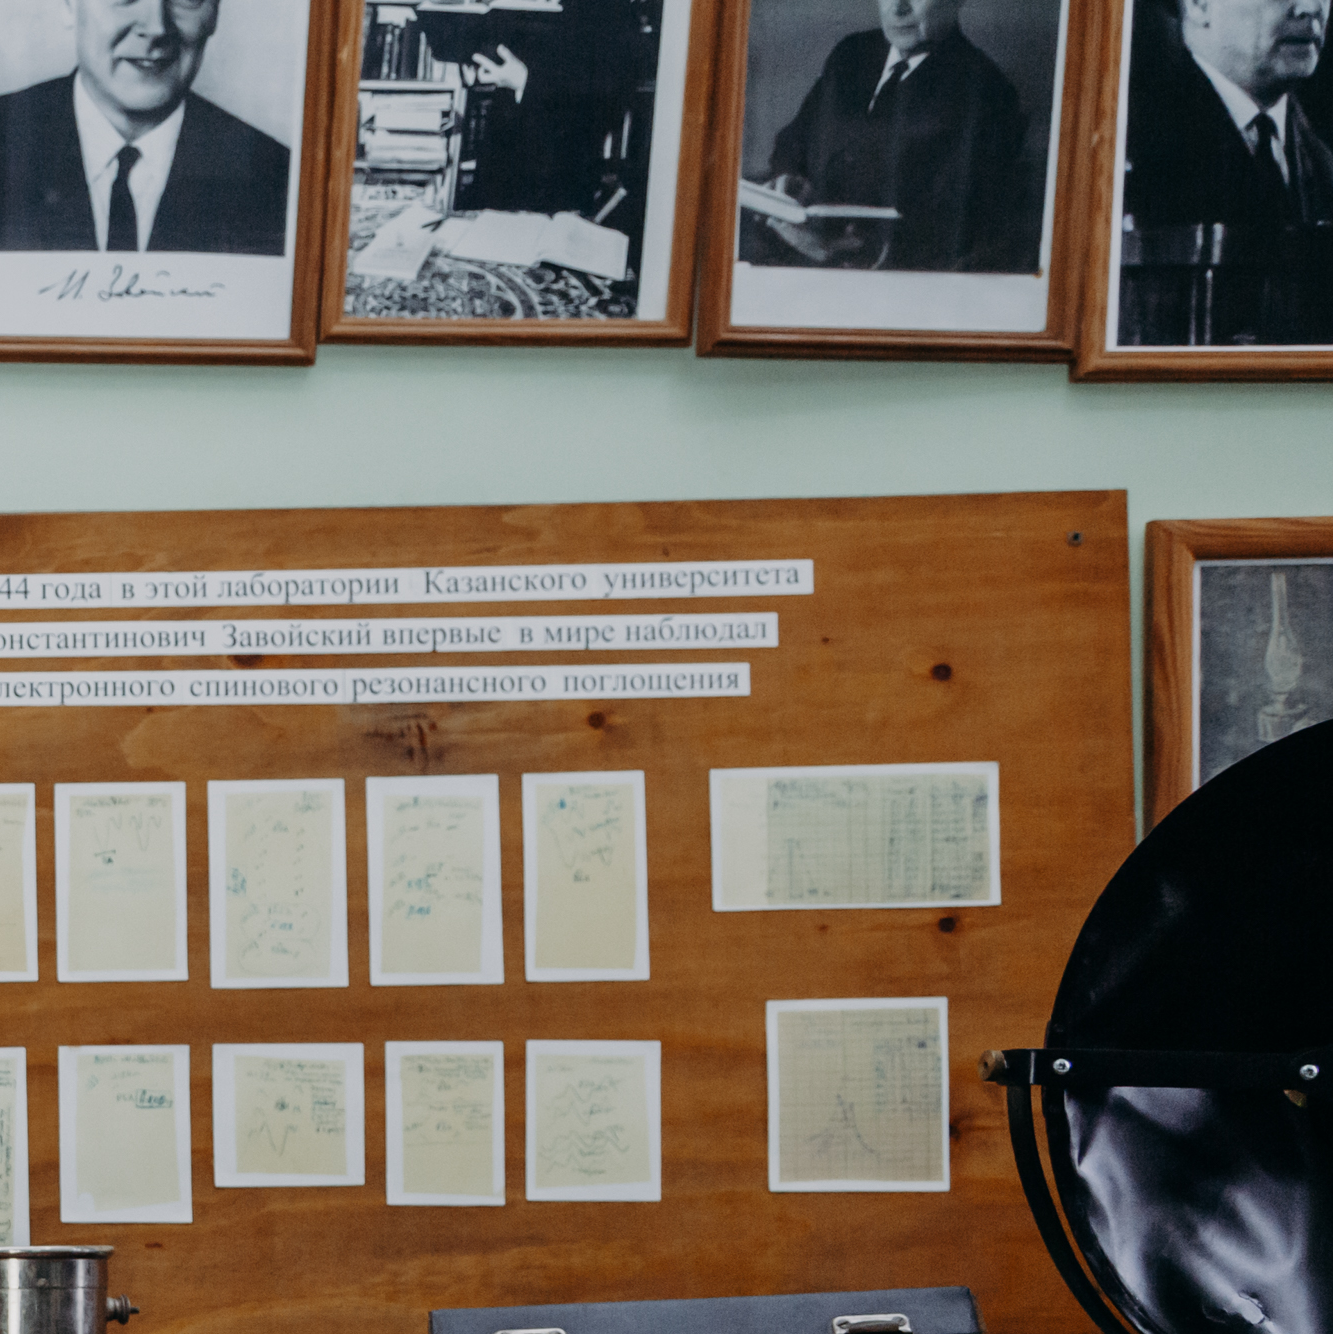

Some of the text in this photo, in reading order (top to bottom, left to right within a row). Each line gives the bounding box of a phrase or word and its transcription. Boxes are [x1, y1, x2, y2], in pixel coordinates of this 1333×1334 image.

[40, 582, 102, 602] года
[121, 582, 135, 599] в
[145, 575, 208, 600] этой
[218, 572, 400, 604] лаборатории
[423, 569, 587, 595] Казанского
[603, 565, 800, 598] университета
[221, 622, 371, 648] Завойский
[382, 625, 502, 653] впервые
[519, 626, 534, 643] в
[543, 624, 616, 649] мире
[625, 617, 768, 643] наблюдал
[189, 676, 339, 698] спинового
[351, 671, 547, 702] резонансного
[562, 670, 741, 694] поглощения
